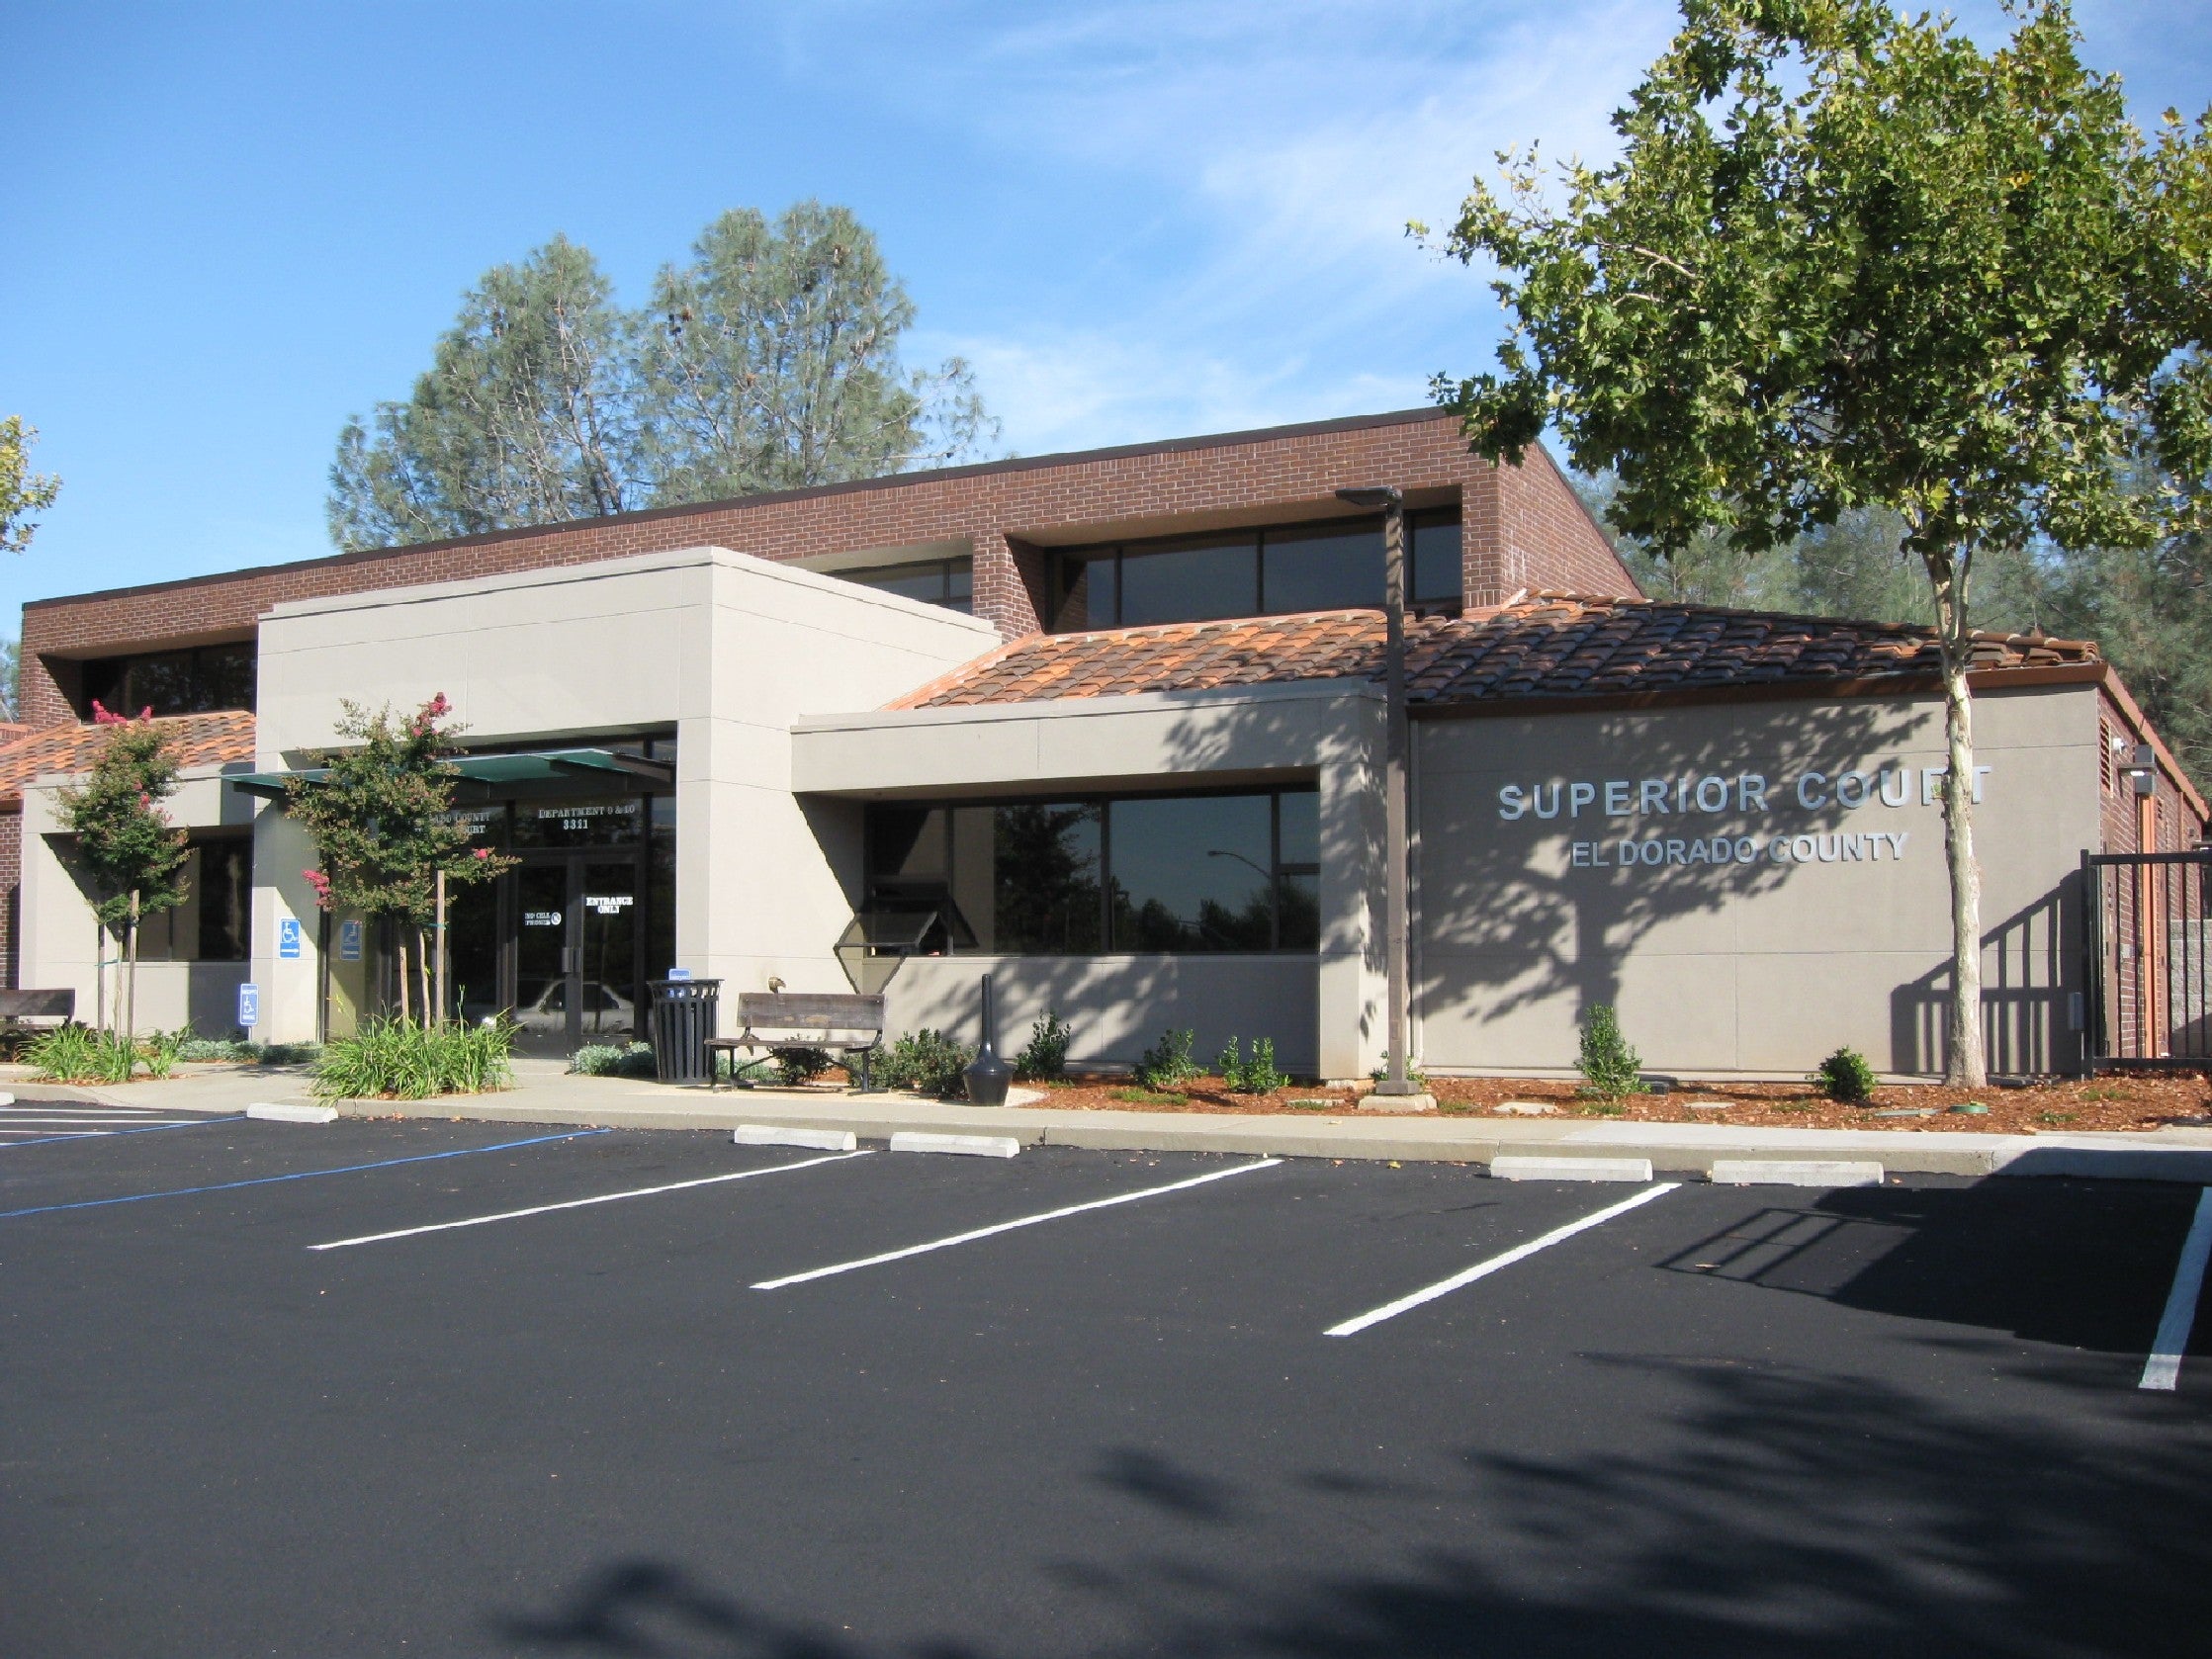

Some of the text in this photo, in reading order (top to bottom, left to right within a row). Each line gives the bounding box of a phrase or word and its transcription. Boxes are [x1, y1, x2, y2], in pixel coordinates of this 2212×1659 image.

[1498, 774, 1769, 822] SUPERIOR
[538, 806, 604, 819] DEPARTMENT
[1572, 832, 1909, 867] EL DORADO COUNTY
[585, 897, 634, 907] ENTRANCE
[597, 905, 620, 914] ONLY
